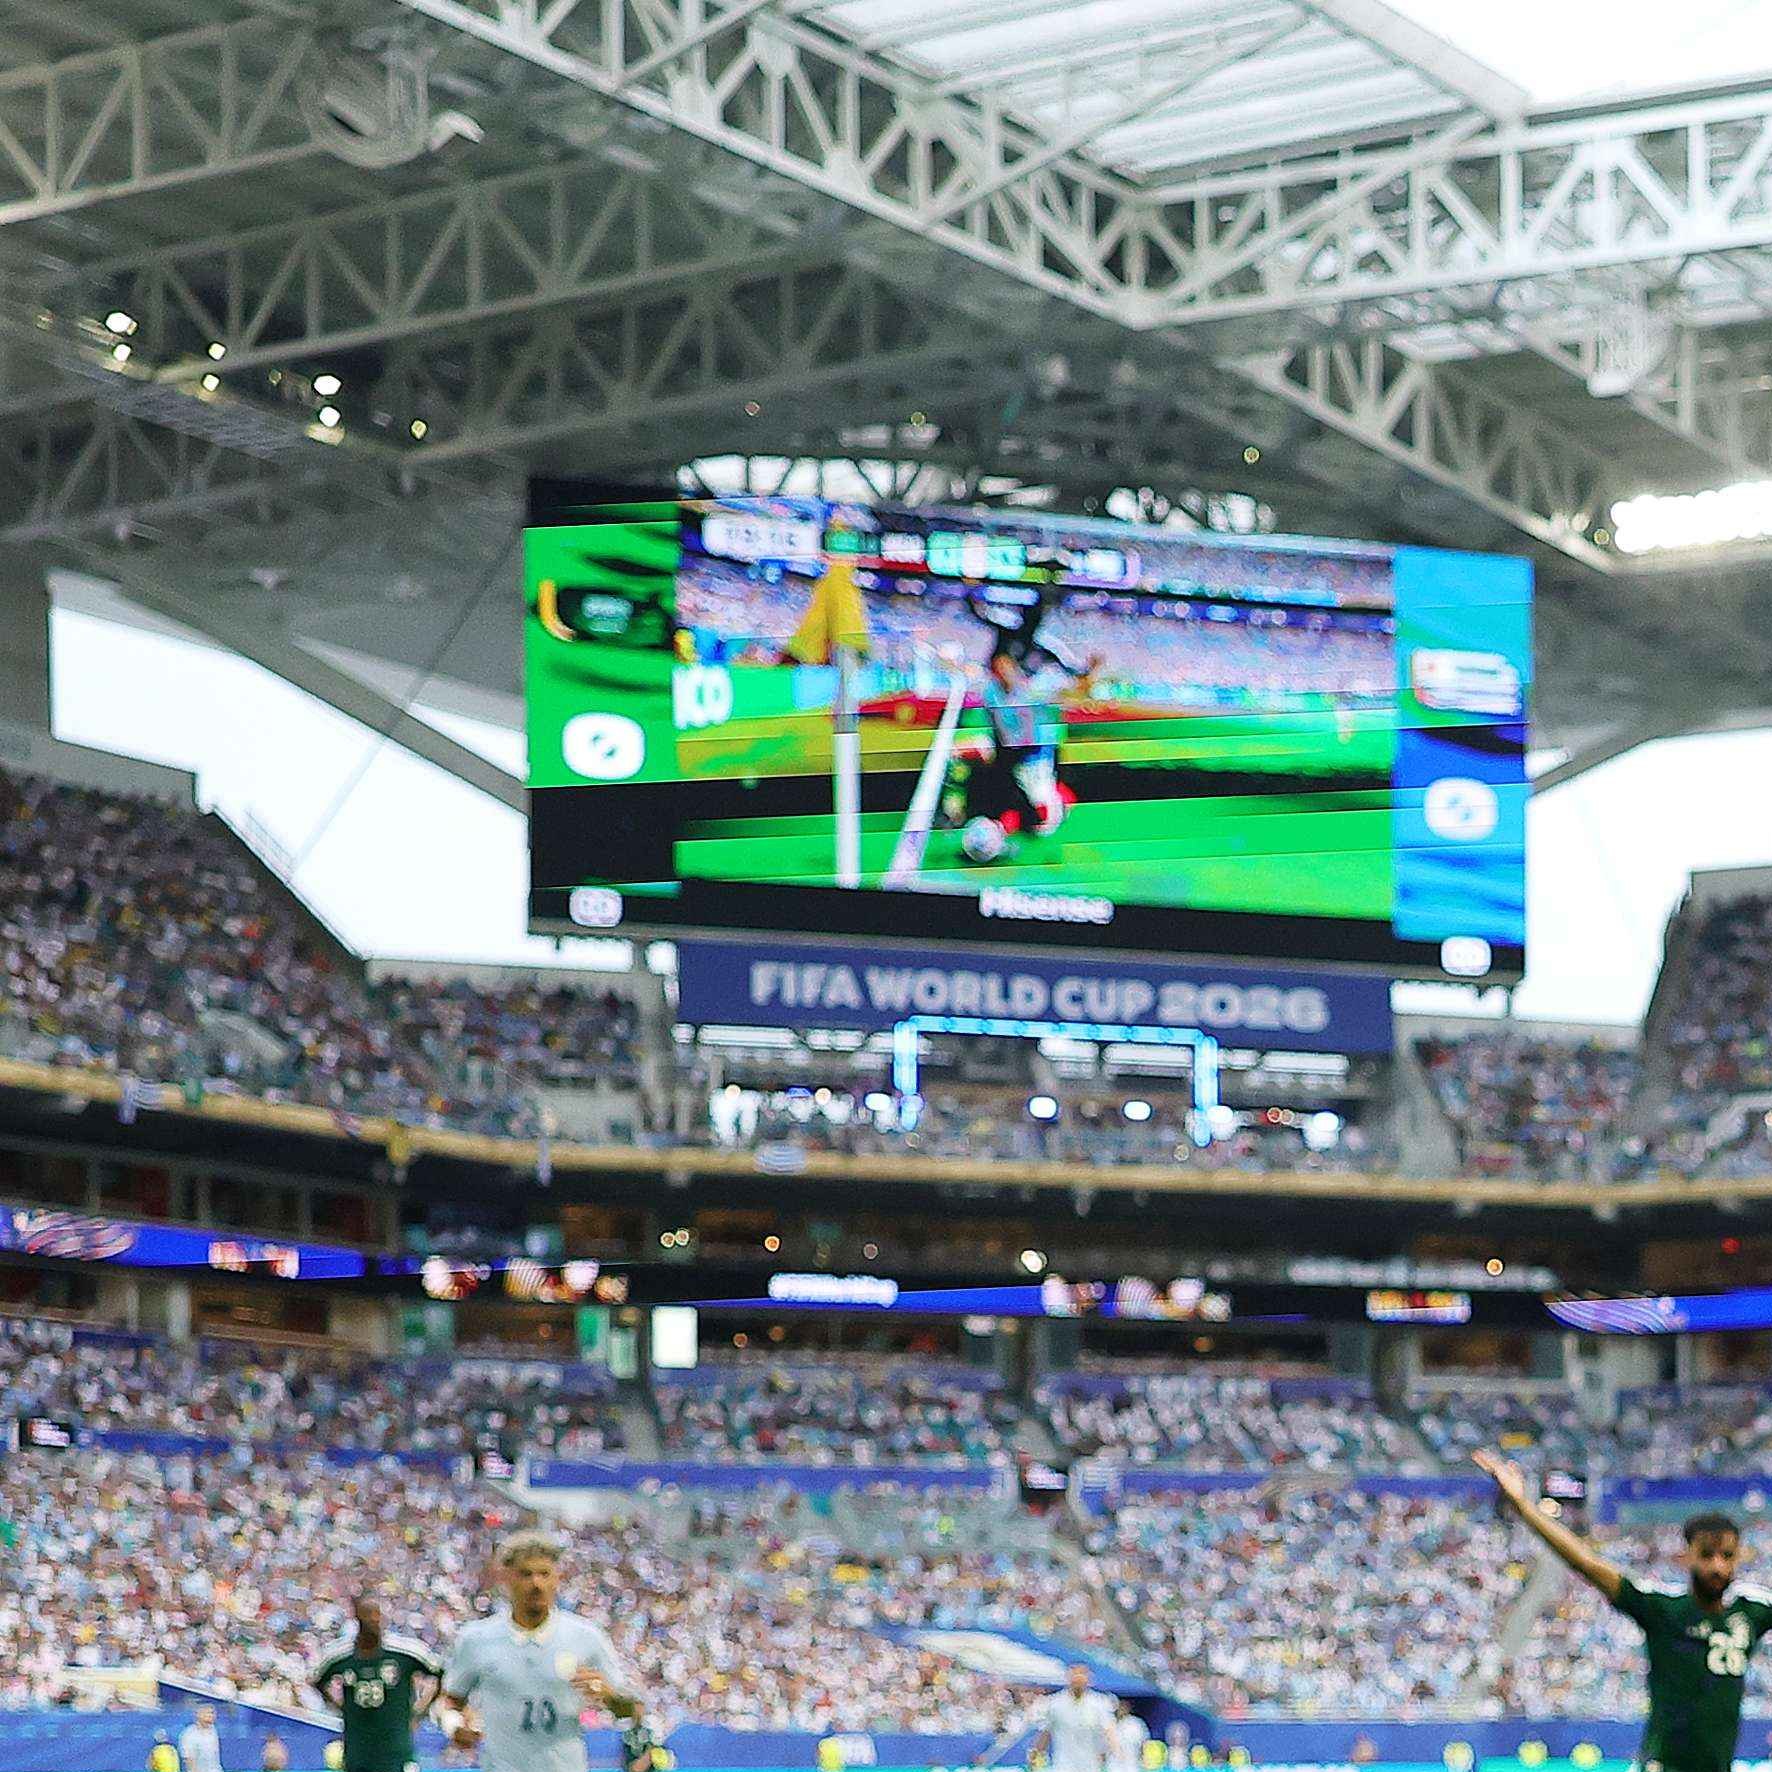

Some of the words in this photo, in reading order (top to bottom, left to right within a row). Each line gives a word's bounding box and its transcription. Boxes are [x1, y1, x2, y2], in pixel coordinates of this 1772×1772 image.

[750, 961, 861, 1009] FIFA
[865, 967, 1046, 1020] WORLD
[1052, 977, 1158, 1026] CUP
[1159, 981, 1331, 1034] 2026
